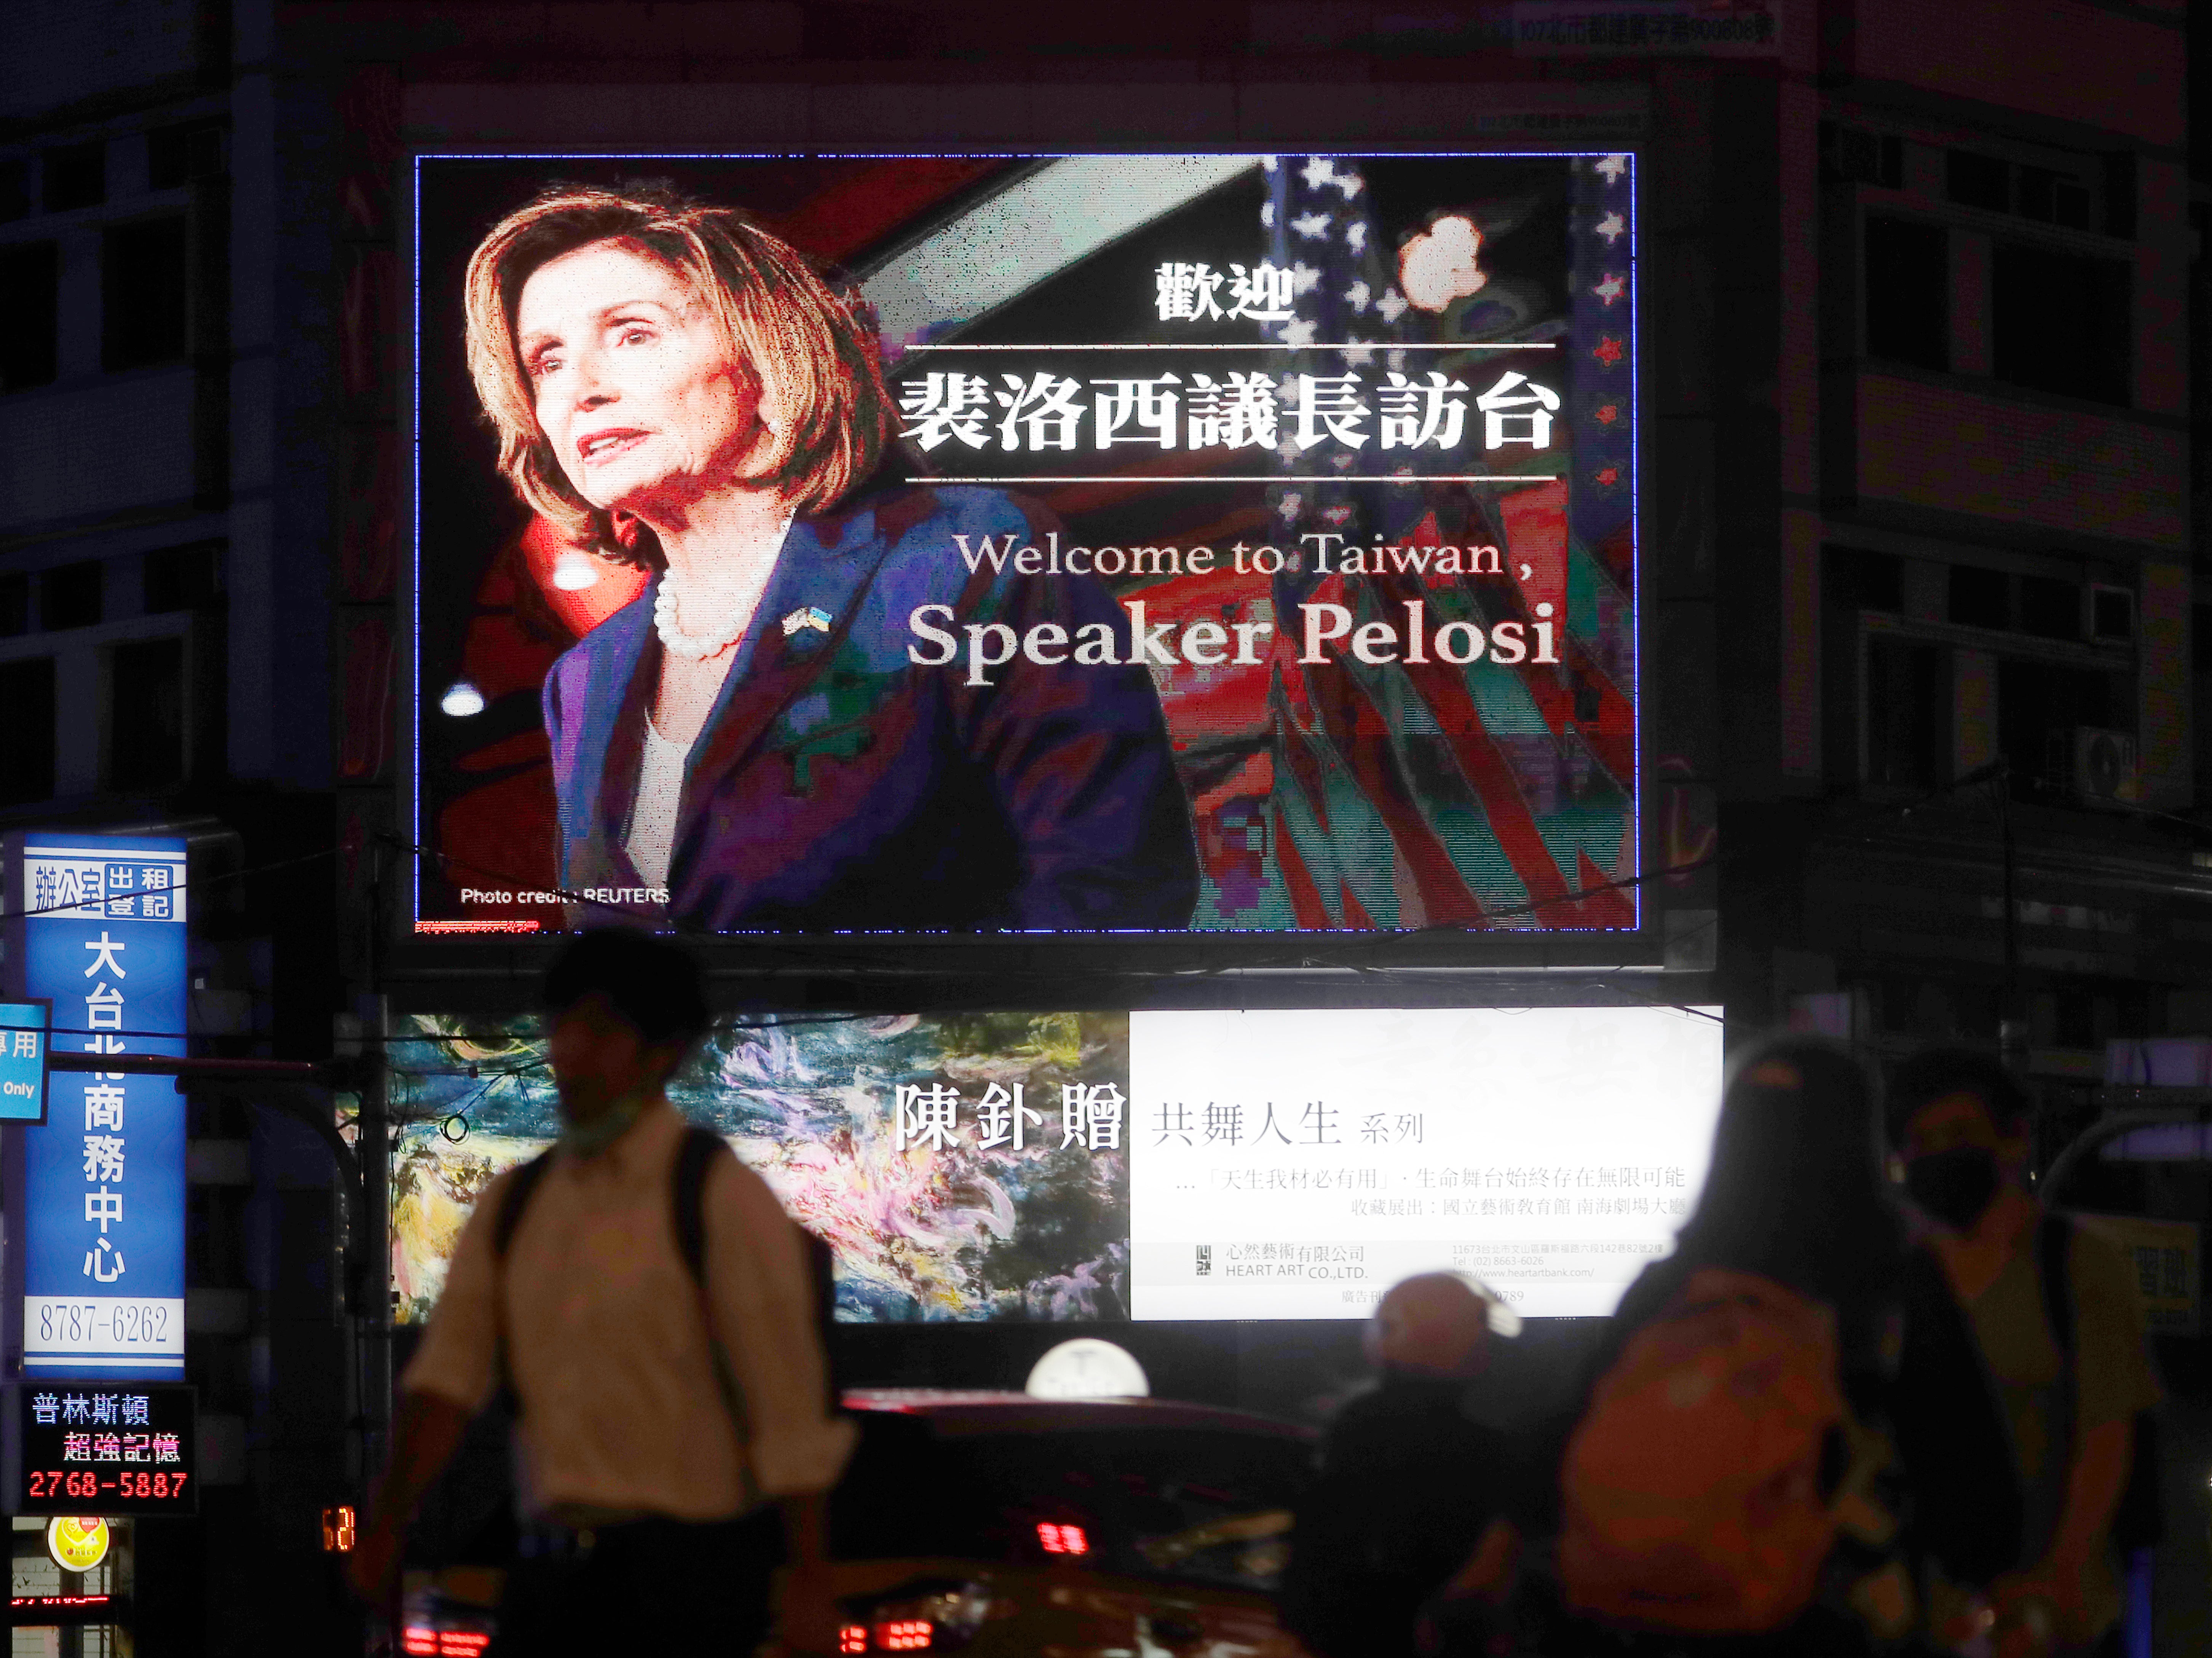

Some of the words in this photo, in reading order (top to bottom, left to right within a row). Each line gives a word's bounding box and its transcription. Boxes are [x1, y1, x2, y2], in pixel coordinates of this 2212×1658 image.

[1154, 262, 1295, 322] 歡迎
[899, 371, 1561, 452] 裴洛西議長訪台
[951, 532, 1216, 575] Welcome
[1232, 541, 1284, 574] to
[908, 600, 1272, 686] Speaker
[1297, 600, 1558, 664] Pelosi
[36, 866, 100, 911] 辦公室
[109, 867, 168, 890] 出租
[108, 895, 169, 918] 登記
[461, 889, 512, 903] Photo
[583, 888, 669, 903] REUTERS
[3, 1081, 35, 1099] Only
[83, 931, 126, 1283] 大台北商務中心
[895, 1082, 1127, 1152] 陳釙贈
[1152, 1101, 1342, 1147] 共舞人生
[1360, 1112, 1423, 1144] 系列
[1226, 1243, 1364, 1262] 心然藝術有限公司
[1473, 1256, 1491, 1267] (02)
[1494, 1256, 1544, 1266] 8663-6026
[1226, 1264, 1273, 1276] HEART
[1277, 1264, 1305, 1276] ART
[1309, 1267, 1369, 1280] CO.,LTD.
[1341, 1290, 1388, 1304] 廣告刊
[41, 1304, 167, 1342] 8787-6262
[32, 1393, 149, 1425] 普林斯頓
[64, 1431, 181, 1464] 超強記憶
[29, 1471, 188, 1498] 2768-5887
